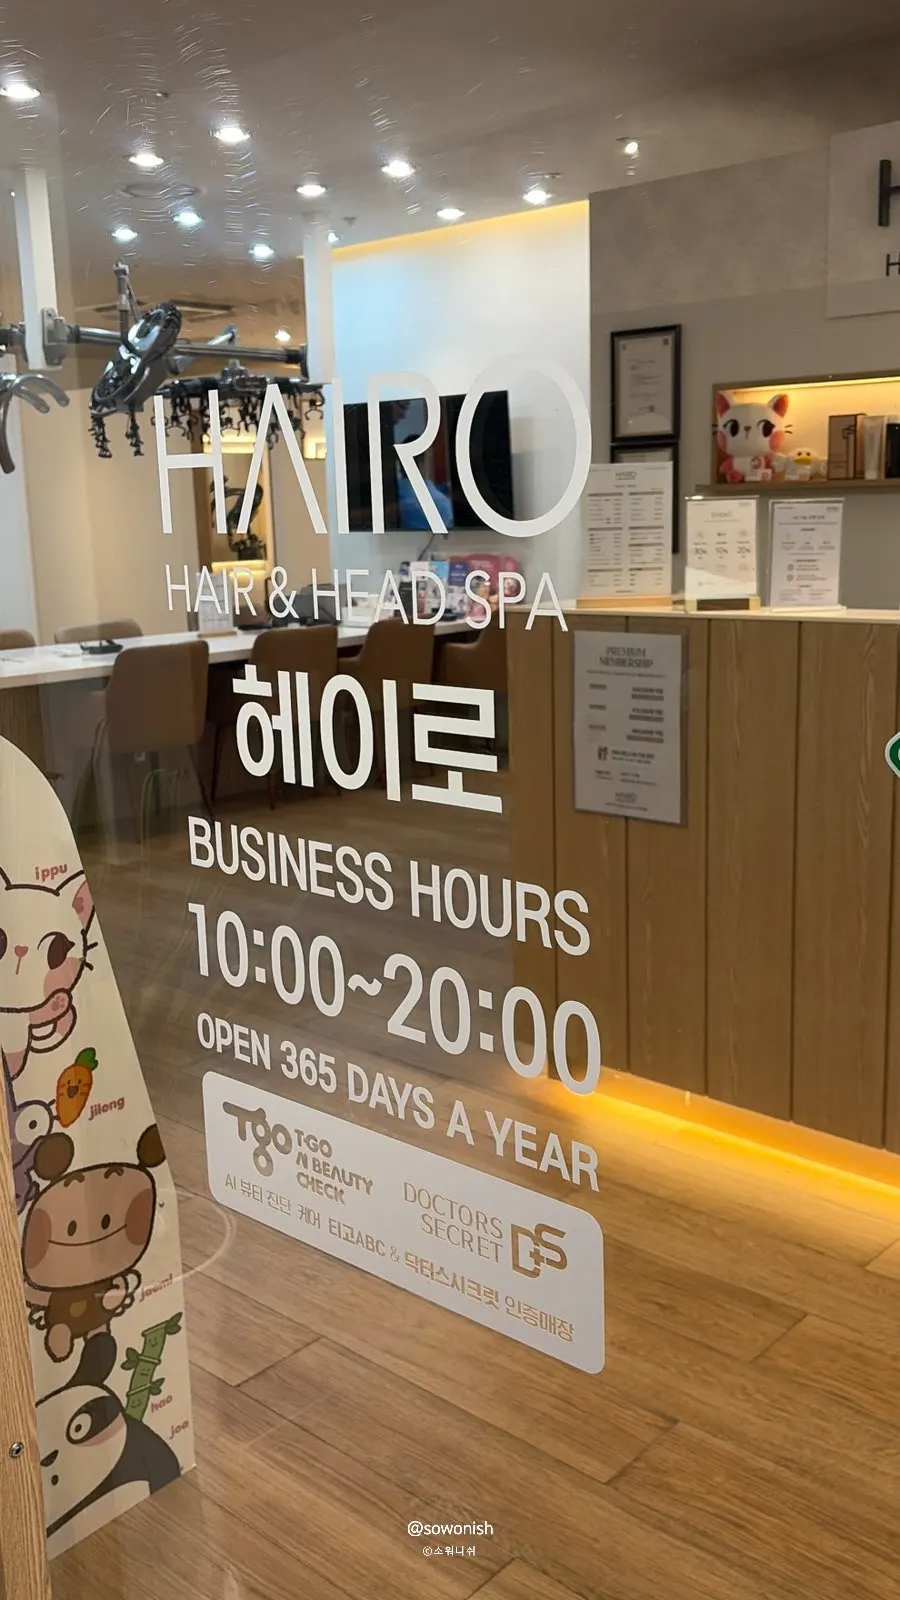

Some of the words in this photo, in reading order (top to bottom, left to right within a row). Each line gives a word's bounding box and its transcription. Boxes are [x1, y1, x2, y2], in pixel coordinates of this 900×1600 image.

[153, 353, 592, 538] HAIRO
[165, 564, 258, 616] HAIR
[268, 565, 299, 619] &
[311, 567, 446, 626] HEAD
[465, 569, 568, 632] SPA
[232, 664, 503, 813] 헤이로
[35, 863, 68, 881] ippu
[188, 815, 394, 911] BUSINESS
[409, 860, 591, 956] HOURS
[188, 902, 601, 1096] 10:00~20:00
[88, 1096, 126, 1121] jilong
[197, 1012, 271, 1070] OPEN
[280, 1040, 338, 1094] 365
[347, 1062, 436, 1130] DAYS
[446, 1100, 475, 1146] A
[485, 1110, 600, 1192] YEAR
[296, 1172, 346, 1206] CHECK
[312, 1157, 374, 1195] BEAUTY
[403, 1182, 503, 1239] DOCTORS
[421, 1213, 504, 1263] SECRET
[225, 1173, 237, 1191] AI
[240, 1178, 263, 1204] 뷰티
[267, 1190, 292, 1216] 진단
[297, 1203, 321, 1229] 케어
[404, 1251, 500, 1310] 닥터스시크릿
[504, 1295, 575, 1342] 인증매장
